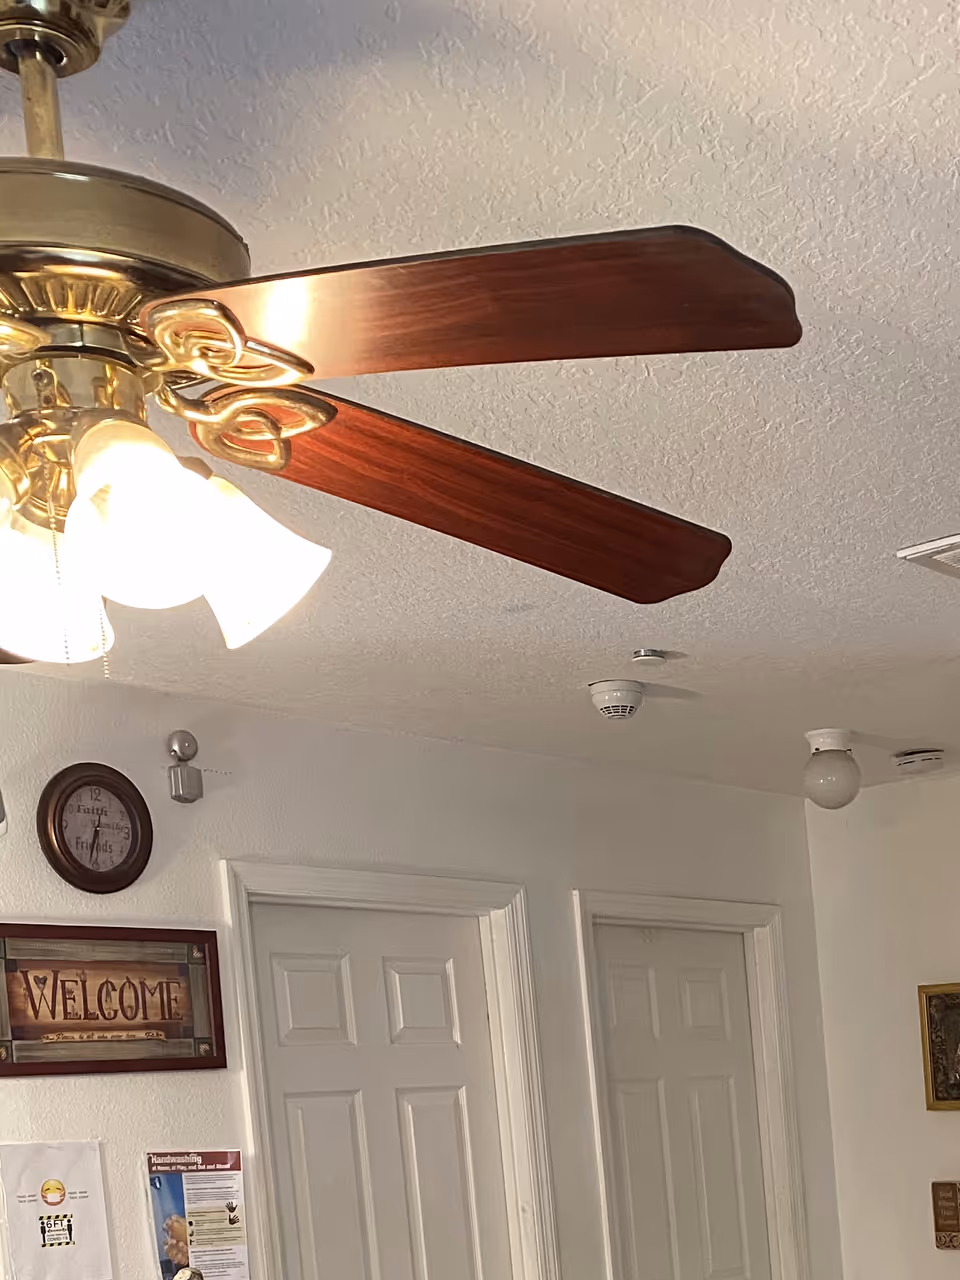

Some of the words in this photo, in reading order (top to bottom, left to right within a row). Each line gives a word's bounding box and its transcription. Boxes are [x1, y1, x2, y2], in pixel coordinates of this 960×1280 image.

[90, 787, 101, 802] 12
[123, 826, 130, 841] 3
[75, 836, 113, 853] Frids
[19, 968, 184, 1022] WELCOME
[151, 1154, 202, 1164] Handwashing
[46, 1220, 52, 1228] 6
